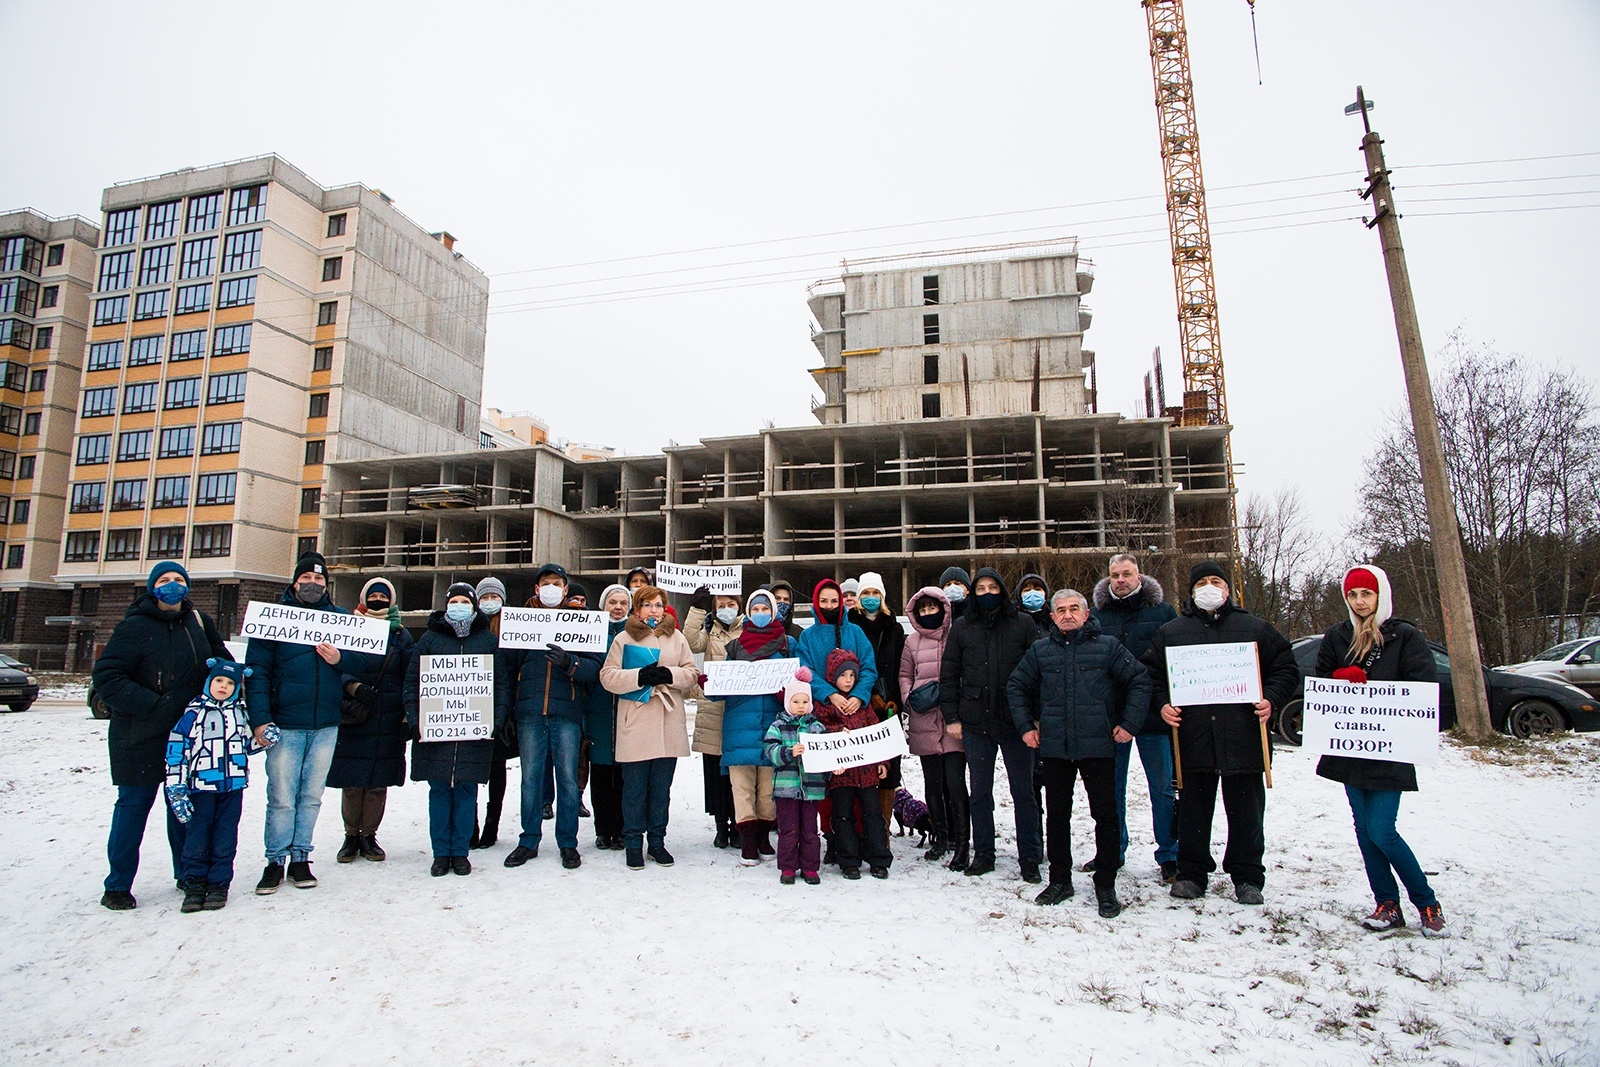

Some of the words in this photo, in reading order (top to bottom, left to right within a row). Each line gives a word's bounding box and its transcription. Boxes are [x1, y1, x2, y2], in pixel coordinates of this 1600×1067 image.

[657, 576, 676, 586] наш
[678, 580, 697, 589] дом
[259, 606, 315, 622] ДЕНЬГИ
[320, 613, 366, 629] ВЗЯЛ?
[503, 611, 552, 623] ЗАКОНОВ
[555, 612, 592, 625] ГОРЫ,
[594, 614, 602, 624] А
[244, 622, 300, 640] ОТДАЙ
[303, 630, 384, 651] КВАРТИРУ!
[501, 631, 542, 643] СТРОЯТ
[554, 632, 601, 645] ВОРЫ!!!
[431, 657, 457, 669] МЫ
[461, 657, 478, 668] НЕ
[707, 661, 799, 677] ПЕТРОСТРОЙ
[420, 672, 492, 683] ОБМАНУТЫЕ
[420, 685, 492, 699] ДОЛЬЩИКИ,
[1306, 679, 1396, 699] Долгострой
[1401, 688, 1410, 697] в
[446, 699, 467, 709] МЫ
[1306, 702, 1356, 716] городе
[1360, 707, 1436, 720] воинской
[428, 712, 480, 723] КИНУТЫЕ
[427, 728, 444, 738] ПО
[447, 727, 466, 737] 214
[472, 726, 488, 736] ФЗ
[1334, 720, 1386, 732] славы.
[1329, 737, 1393, 753] ПОЗОР!
[836, 753, 864, 764] полк
